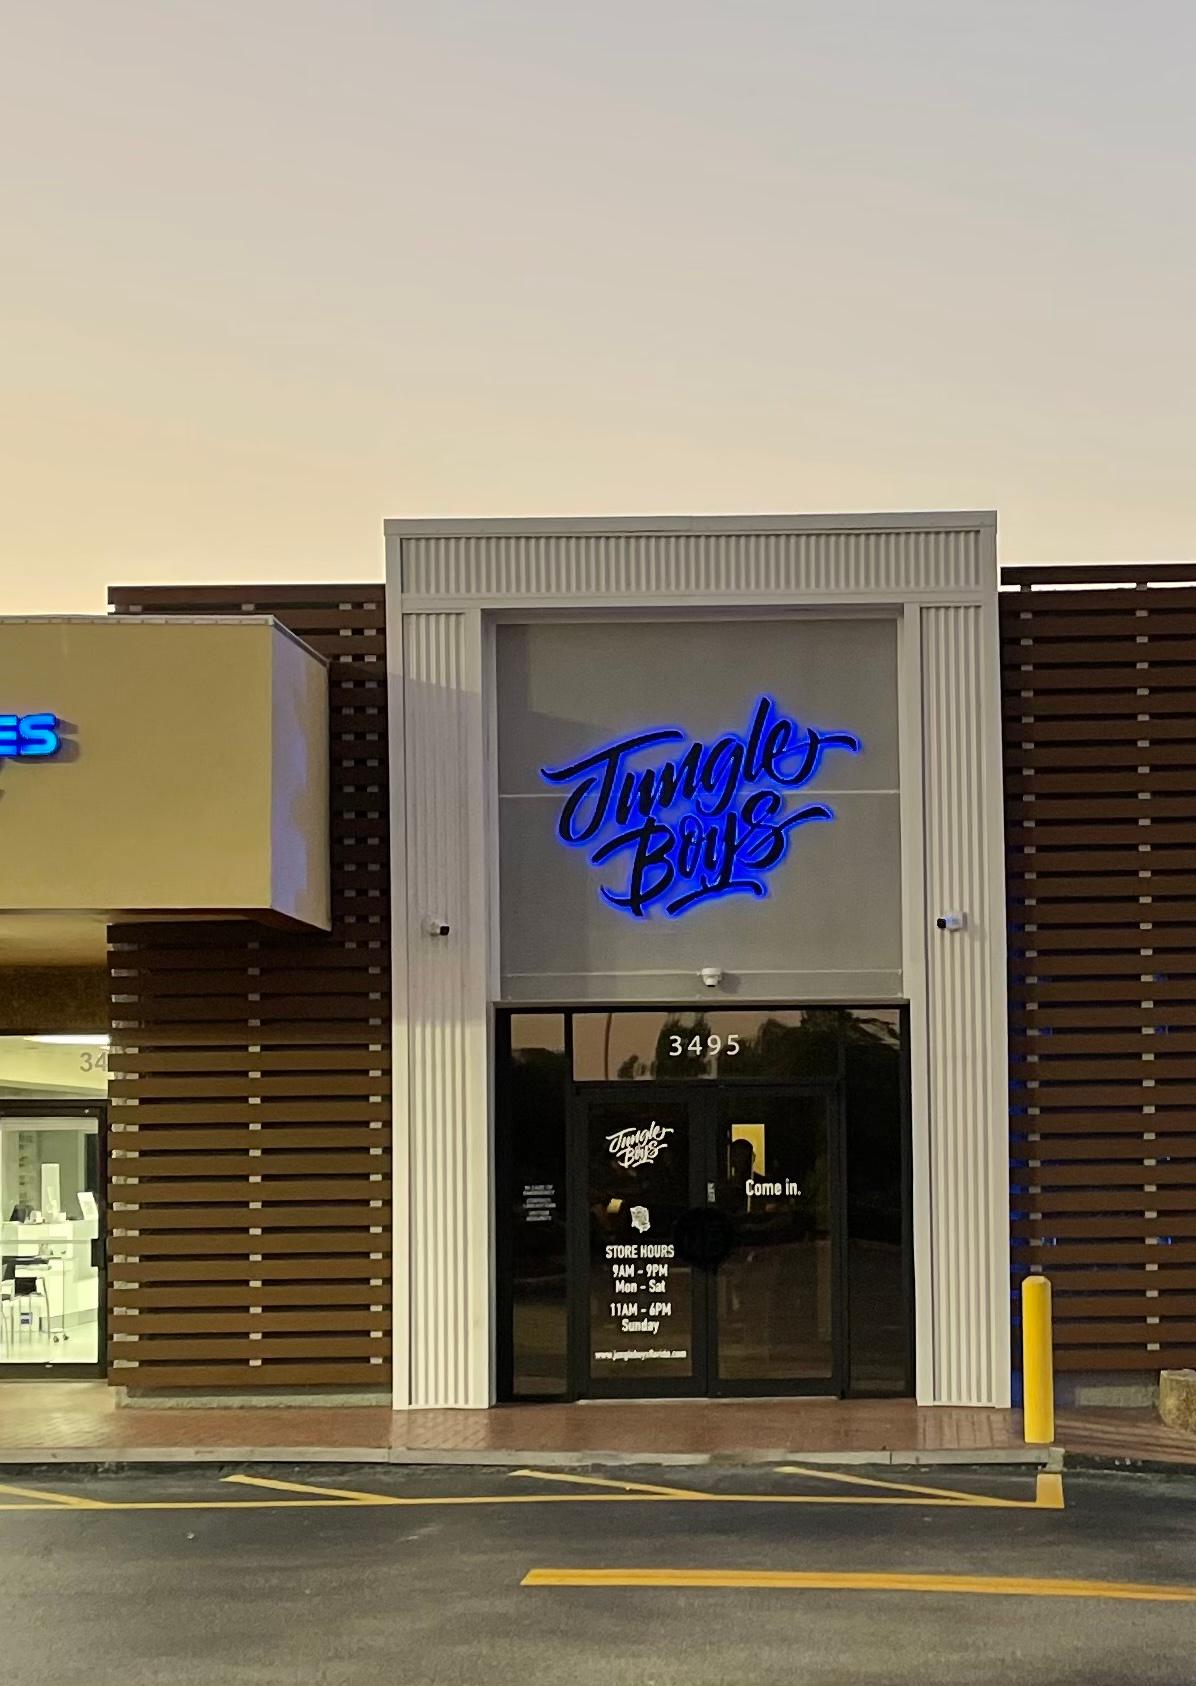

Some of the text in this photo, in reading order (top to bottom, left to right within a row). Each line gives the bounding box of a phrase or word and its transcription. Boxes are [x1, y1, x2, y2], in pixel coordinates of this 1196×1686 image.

[540, 696, 861, 842] Jungle
[591, 790, 832, 917] Boys
[669, 1034, 740, 1056] 3495
[605, 1121, 675, 1153] Jungle
[616, 1141, 668, 1168] Boys
[745, 1177, 802, 1196] Come in.
[605, 1244, 675, 1259] STORE HOURS
[612, 1263, 635, 1278] 9AM
[646, 1263, 669, 1277] 9PM
[615, 1279, 638, 1293] Mon
[649, 1279, 666, 1293] Sat
[610, 1302, 638, 1317] 11AM
[649, 1302, 672, 1316] 6PM
[621, 1318, 660, 1335] Sunday
